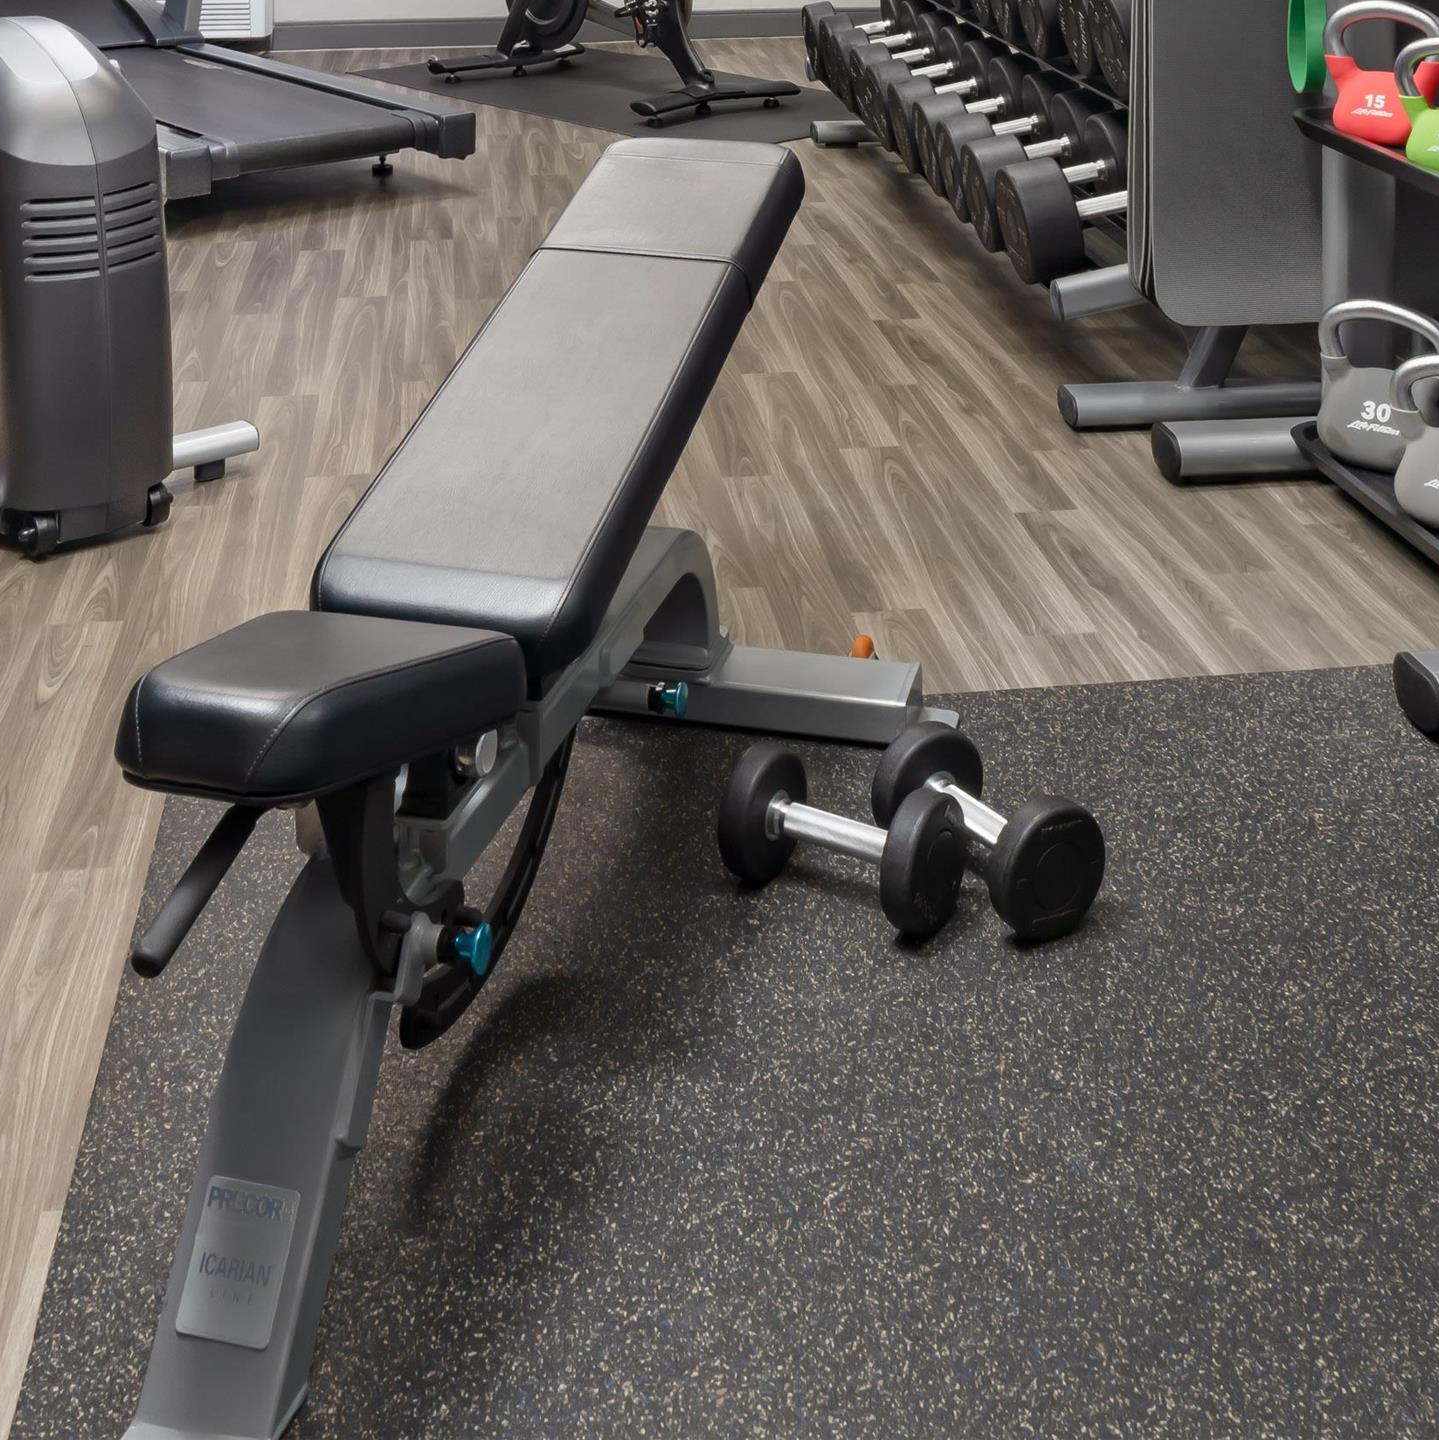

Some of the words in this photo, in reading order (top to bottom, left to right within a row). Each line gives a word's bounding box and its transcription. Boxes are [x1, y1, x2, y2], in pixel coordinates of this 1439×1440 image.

[1364, 93, 1386, 110] 15
[1360, 400, 1392, 423] 30
[198, 1251, 273, 1287] ICARIAN
